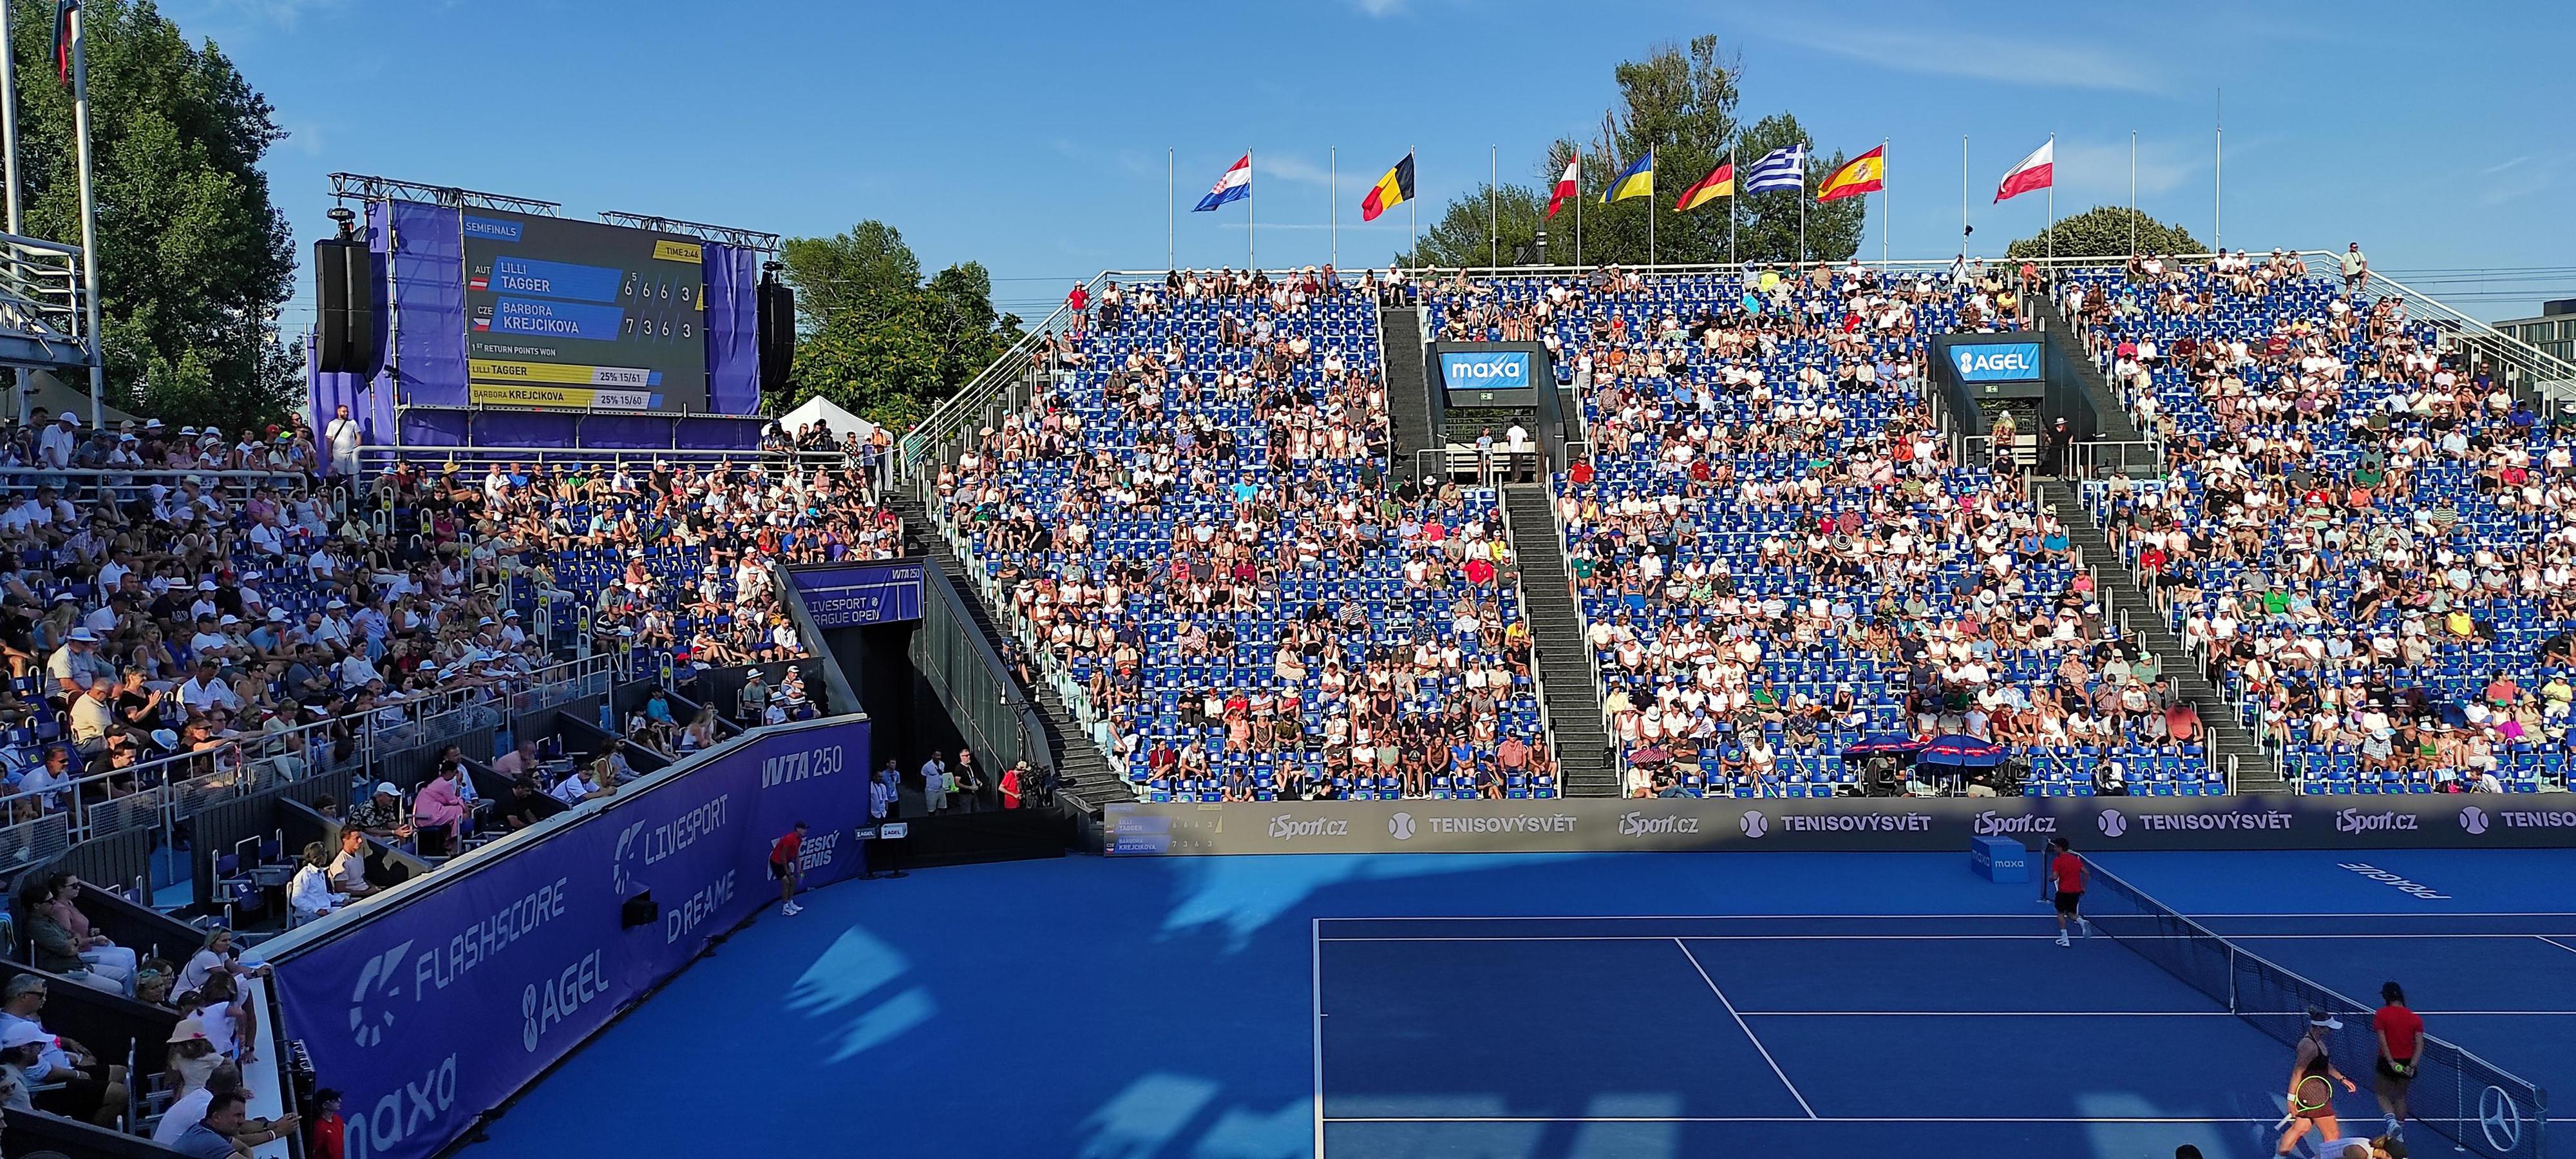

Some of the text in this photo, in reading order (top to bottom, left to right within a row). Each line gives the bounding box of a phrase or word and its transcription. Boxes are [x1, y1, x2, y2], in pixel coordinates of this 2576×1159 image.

[466, 222, 516, 236] SEMIFINALS
[666, 247, 683, 256] TIME
[475, 265, 491, 274] AUT
[501, 262, 526, 274] LILLI
[502, 276, 551, 292] TAGGER
[625, 273, 690, 301] 6 5 6 6 3
[478, 306, 493, 315] CZE
[503, 303, 553, 317] BARBORA
[504, 316, 580, 334] KREJCIKOVA
[626, 319, 691, 338] 7 3 6 3
[484, 345, 513, 354] RETURN
[514, 346, 538, 356] POINTS
[540, 347, 556, 356] WON
[472, 365, 527, 376] LILLI TAGGER
[1452, 362, 1519, 378] maxa
[1974, 354, 2030, 370] AGEL
[600, 372, 640, 383] 25% 15/61
[474, 390, 564, 401] BARBORA KREJCIKOVA
[601, 395, 642, 405] 25% 15/60
[892, 568, 920, 580] WTA 250
[813, 609, 880, 626] RAGUE OPEN
[762, 745, 843, 789] WTA 250
[1268, 814, 1348, 840] iSport.cz
[1429, 814, 1577, 832] TENISOVÝSVĚT
[1618, 810, 1699, 838] iSport.cz
[1781, 812, 1931, 832] TENISOVÝSVĚT
[1974, 810, 2056, 837] iSport.cz
[2139, 809, 2293, 830] TENISOVÝSVĚT
[2336, 807, 2418, 835] iSport.cz
[645, 793, 728, 866] LIVESPORT
[1972, 849, 1990, 867] maxa
[2337, 863, 2452, 899] PRAGUE
[667, 868, 735, 944] DREAME
[415, 877, 567, 1002] FLASHSCORE
[540, 948, 610, 1035] AGEL
